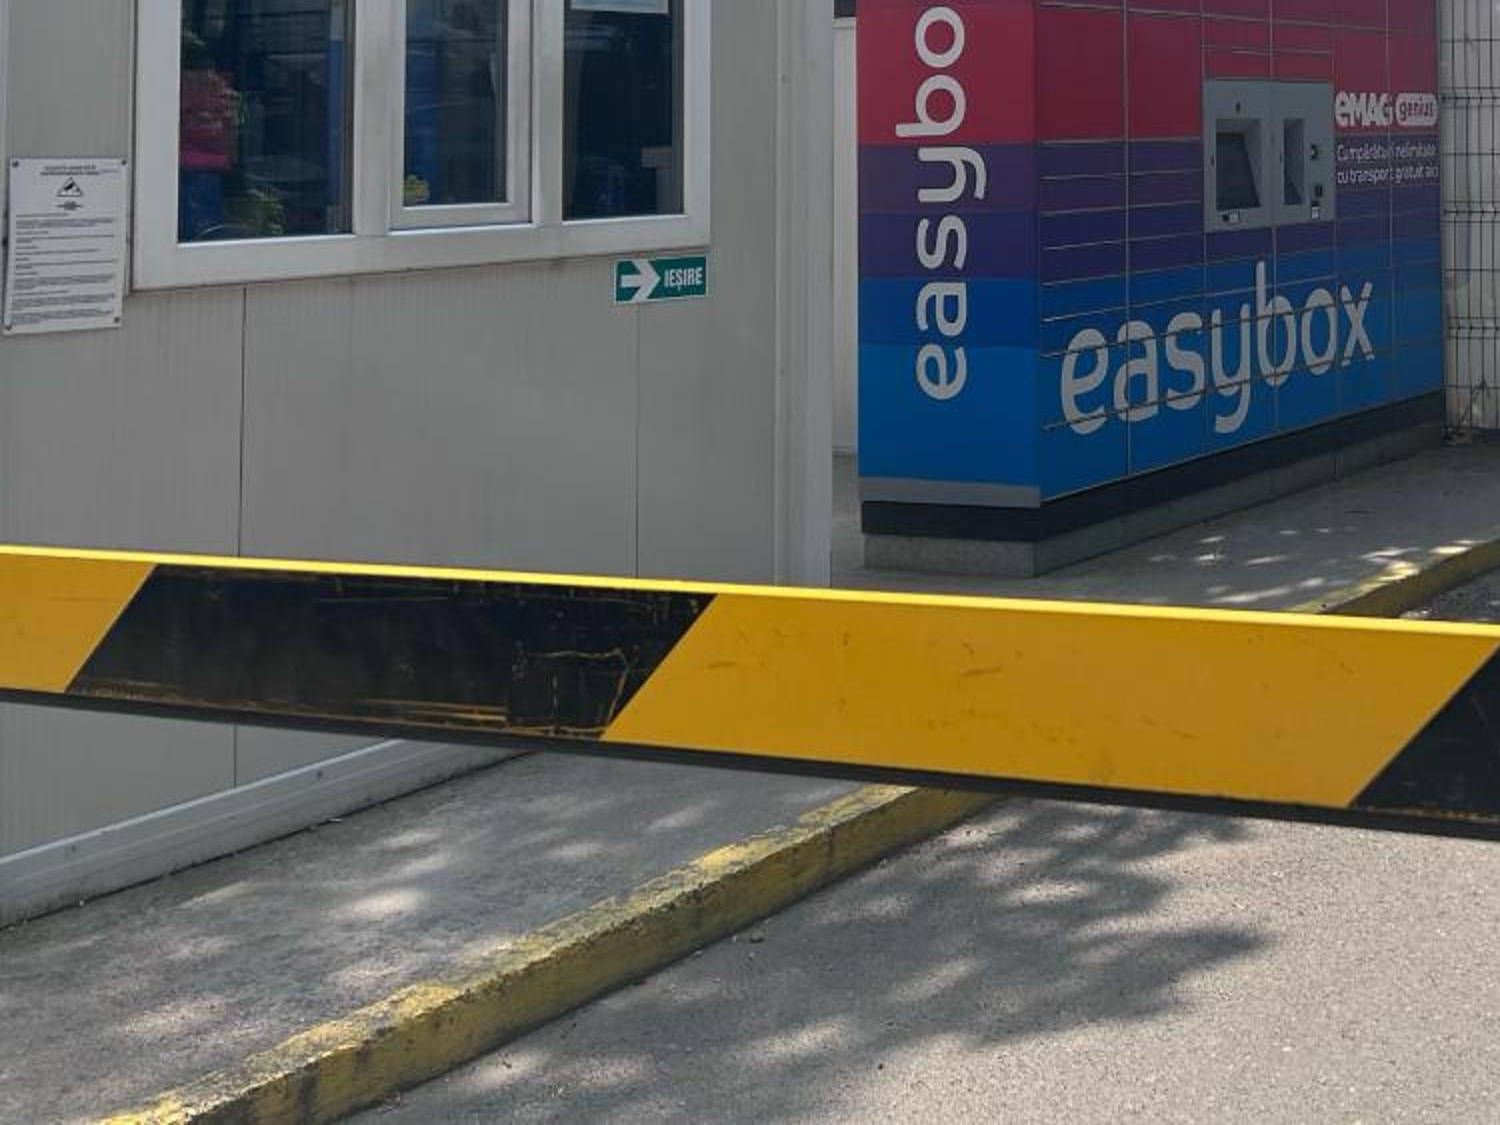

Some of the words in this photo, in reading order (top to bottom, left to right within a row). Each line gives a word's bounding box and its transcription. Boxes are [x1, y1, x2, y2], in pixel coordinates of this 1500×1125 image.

[1399, 96, 1434, 122] genius
[1337, 171, 1349, 184] cu
[1349, 166, 1394, 185] transport
[1061, 259, 1375, 435] easybox
